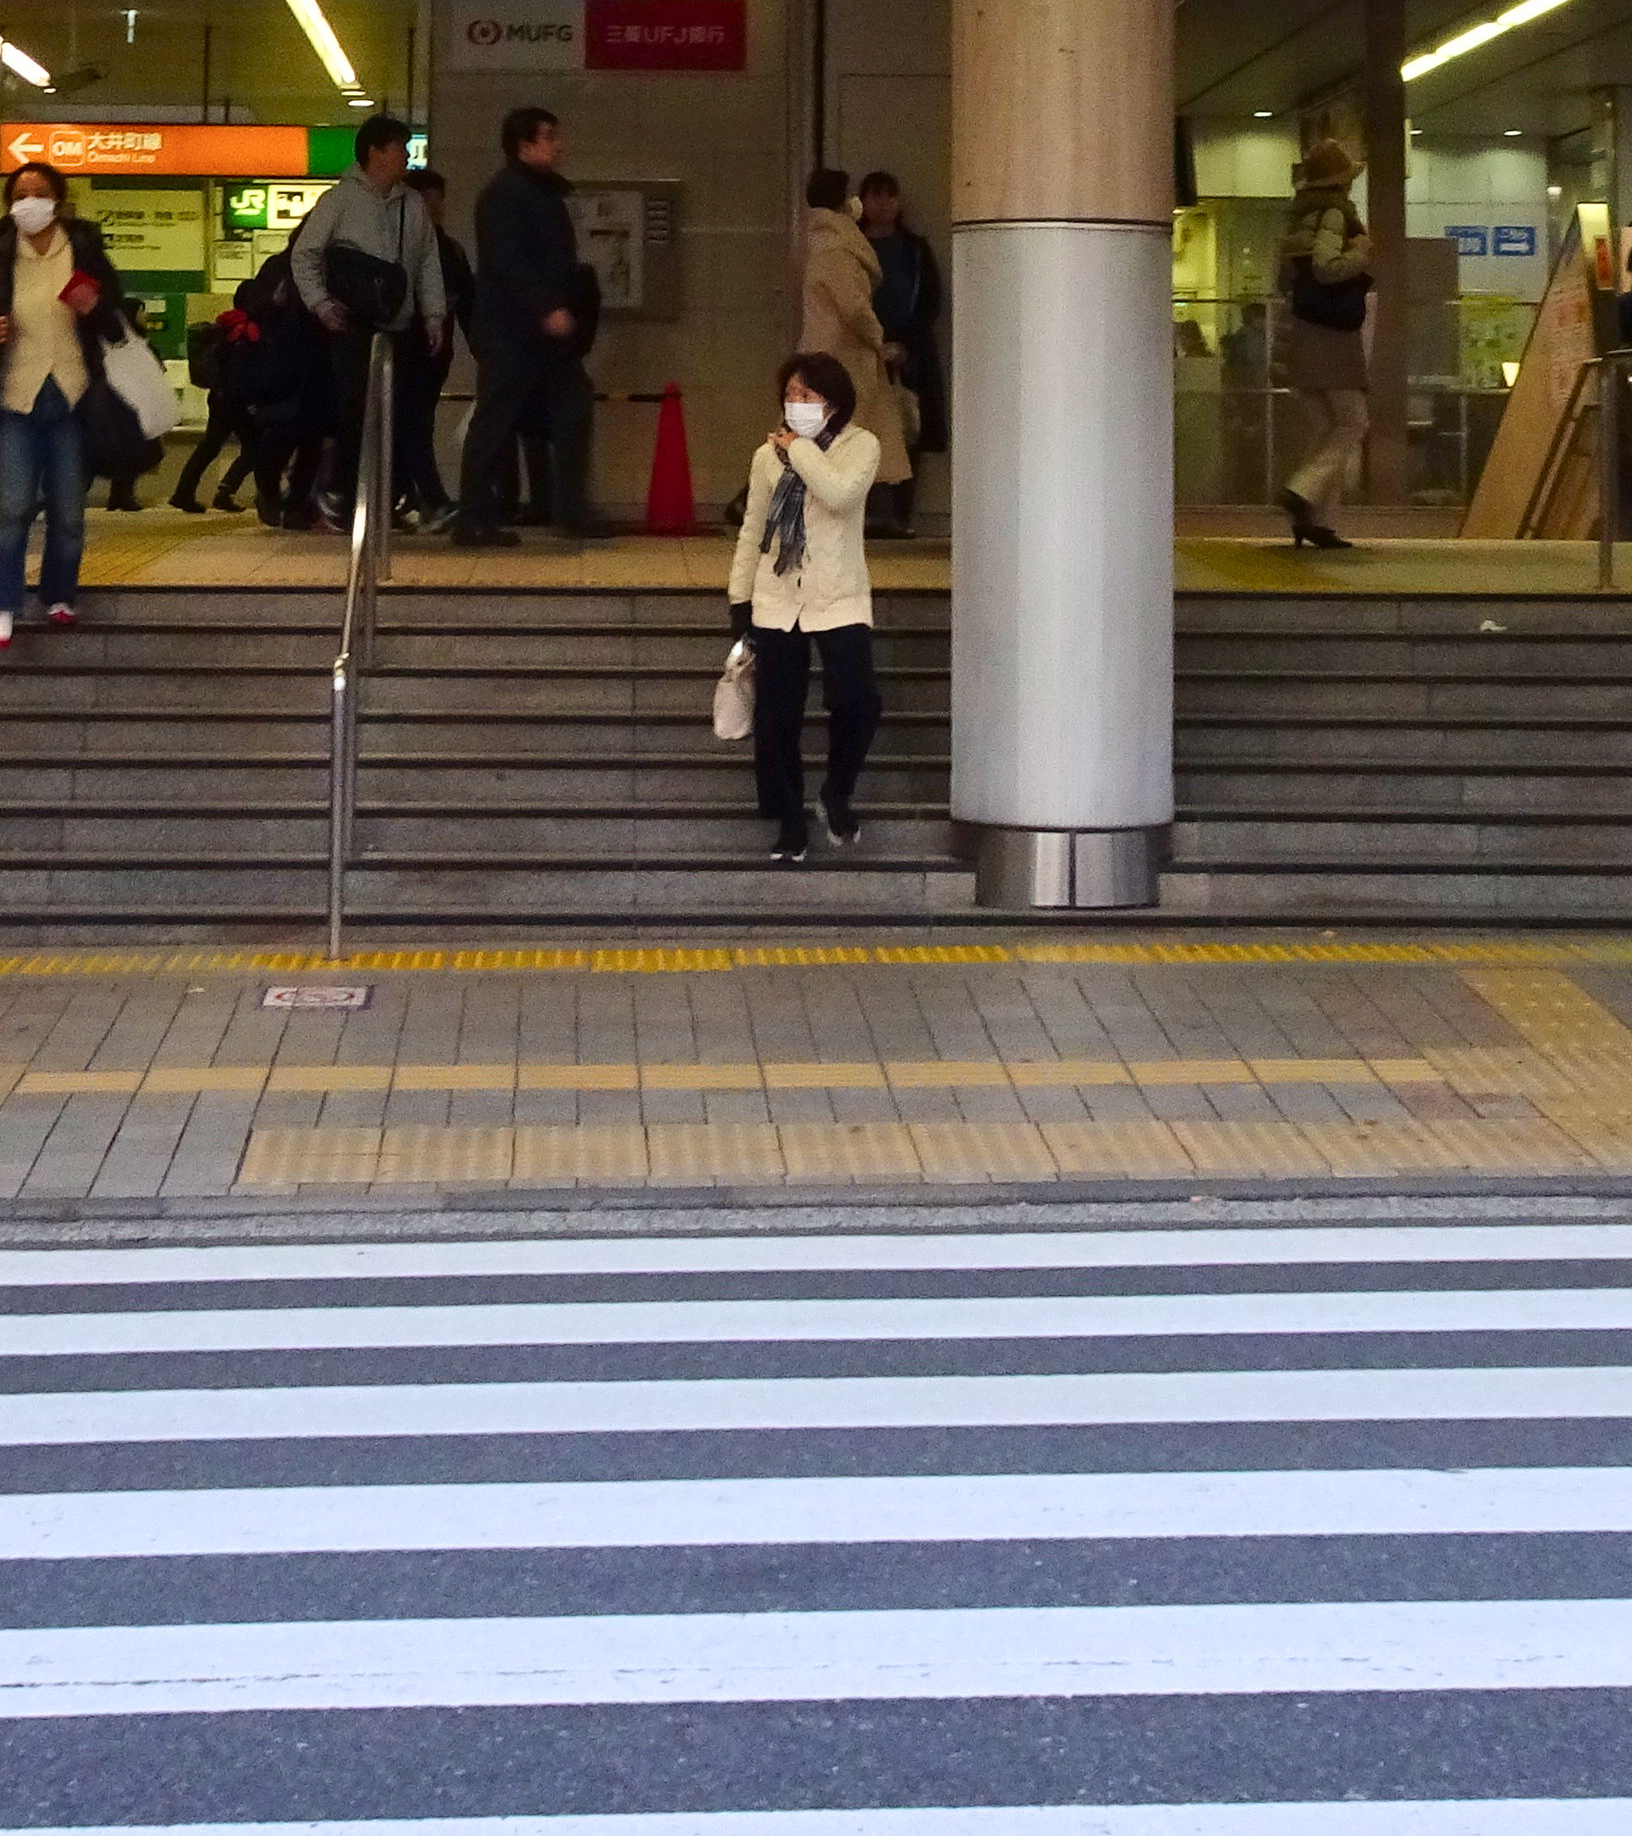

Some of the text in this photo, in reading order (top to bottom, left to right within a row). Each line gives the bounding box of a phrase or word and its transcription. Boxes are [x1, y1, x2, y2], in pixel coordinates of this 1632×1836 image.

[505, 24, 573, 42] MUFG
[605, 24, 726, 45] 三菱UFJ銀行
[87, 131, 163, 151] 大井町線
[229, 189, 267, 209] JR
